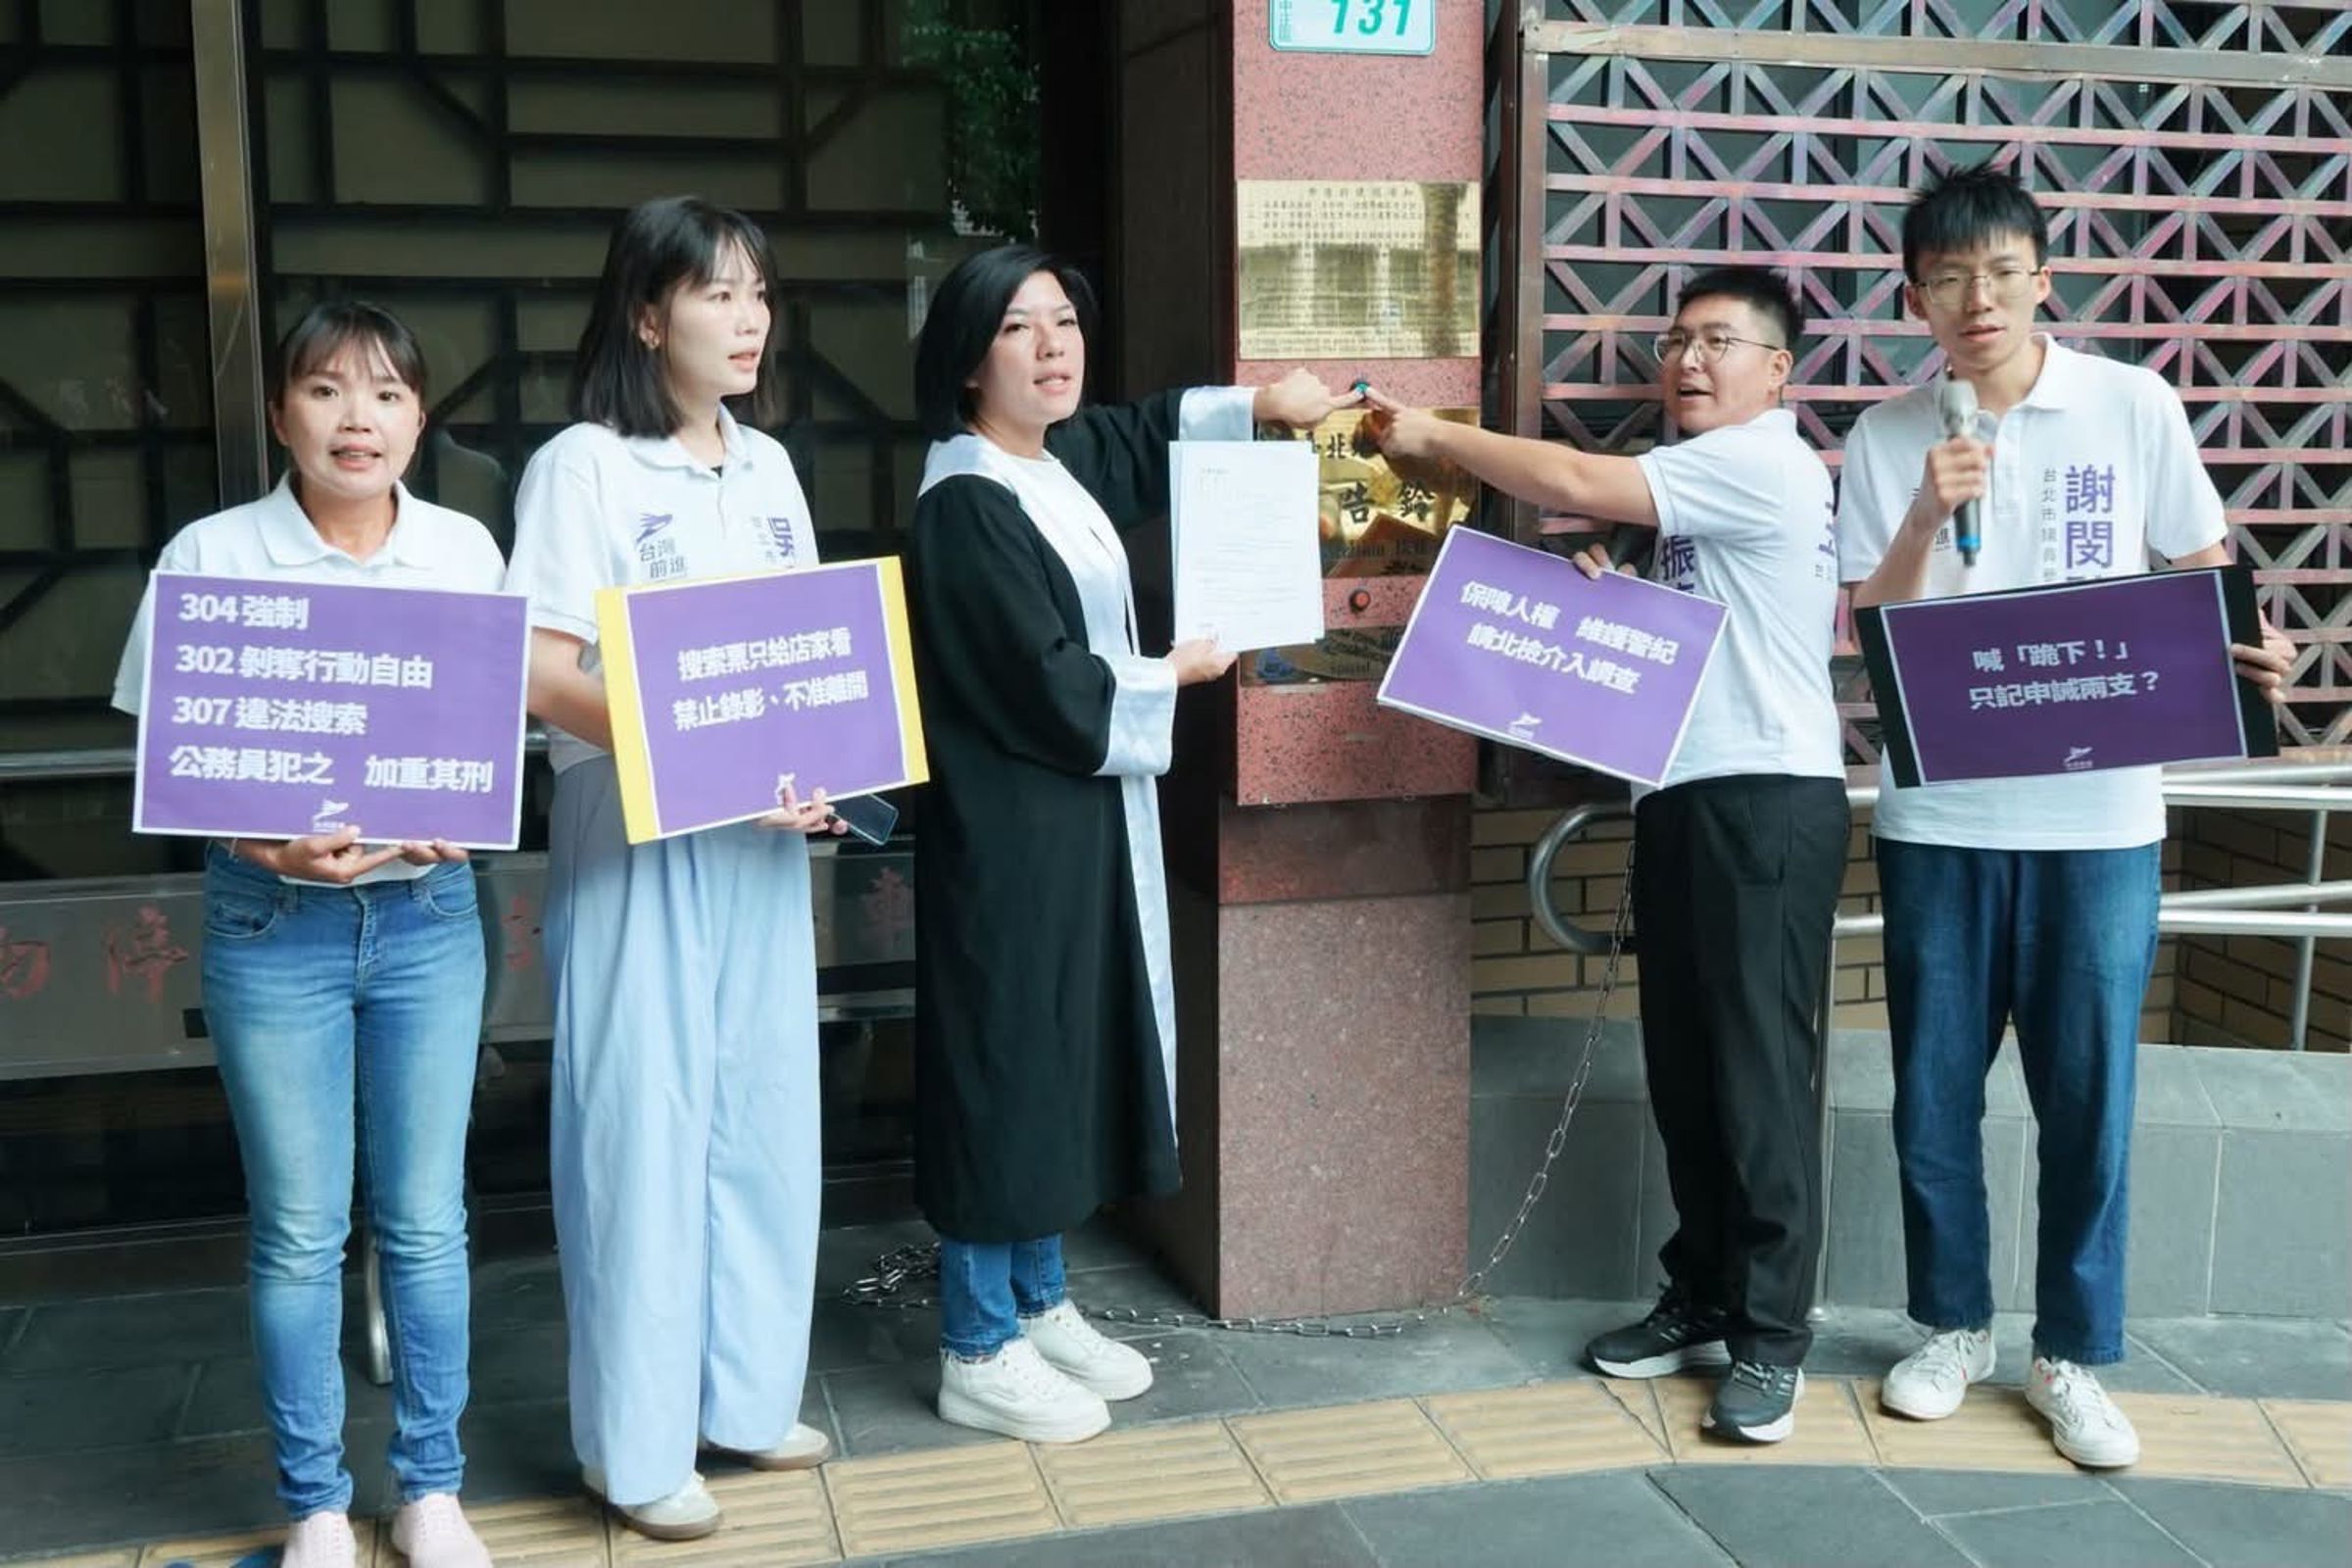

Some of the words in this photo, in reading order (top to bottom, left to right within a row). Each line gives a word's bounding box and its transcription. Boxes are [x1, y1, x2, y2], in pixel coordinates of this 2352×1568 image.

[1331, 0, 1412, 35] 131
[2065, 465, 2116, 580] 謝閔
[1660, 535, 1694, 594] 振
[179, 593, 239, 623] 304
[242, 596, 309, 630] 強制
[1461, 581, 1561, 629] 保障人權
[1576, 616, 1679, 665] 維護警紀
[176, 645, 234, 674] 302
[239, 646, 433, 689] 剝奪行動自由
[677, 627, 852, 681] 搜索票只給店家看
[1467, 622, 1642, 694] 請北檢介入調查
[172, 697, 232, 725] 307
[235, 697, 368, 736] 違法搜索
[672, 670, 869, 731] 禁止錄影、不准離開
[170, 746, 335, 785] 公務員犯之
[365, 756, 493, 793] 加重其刑
